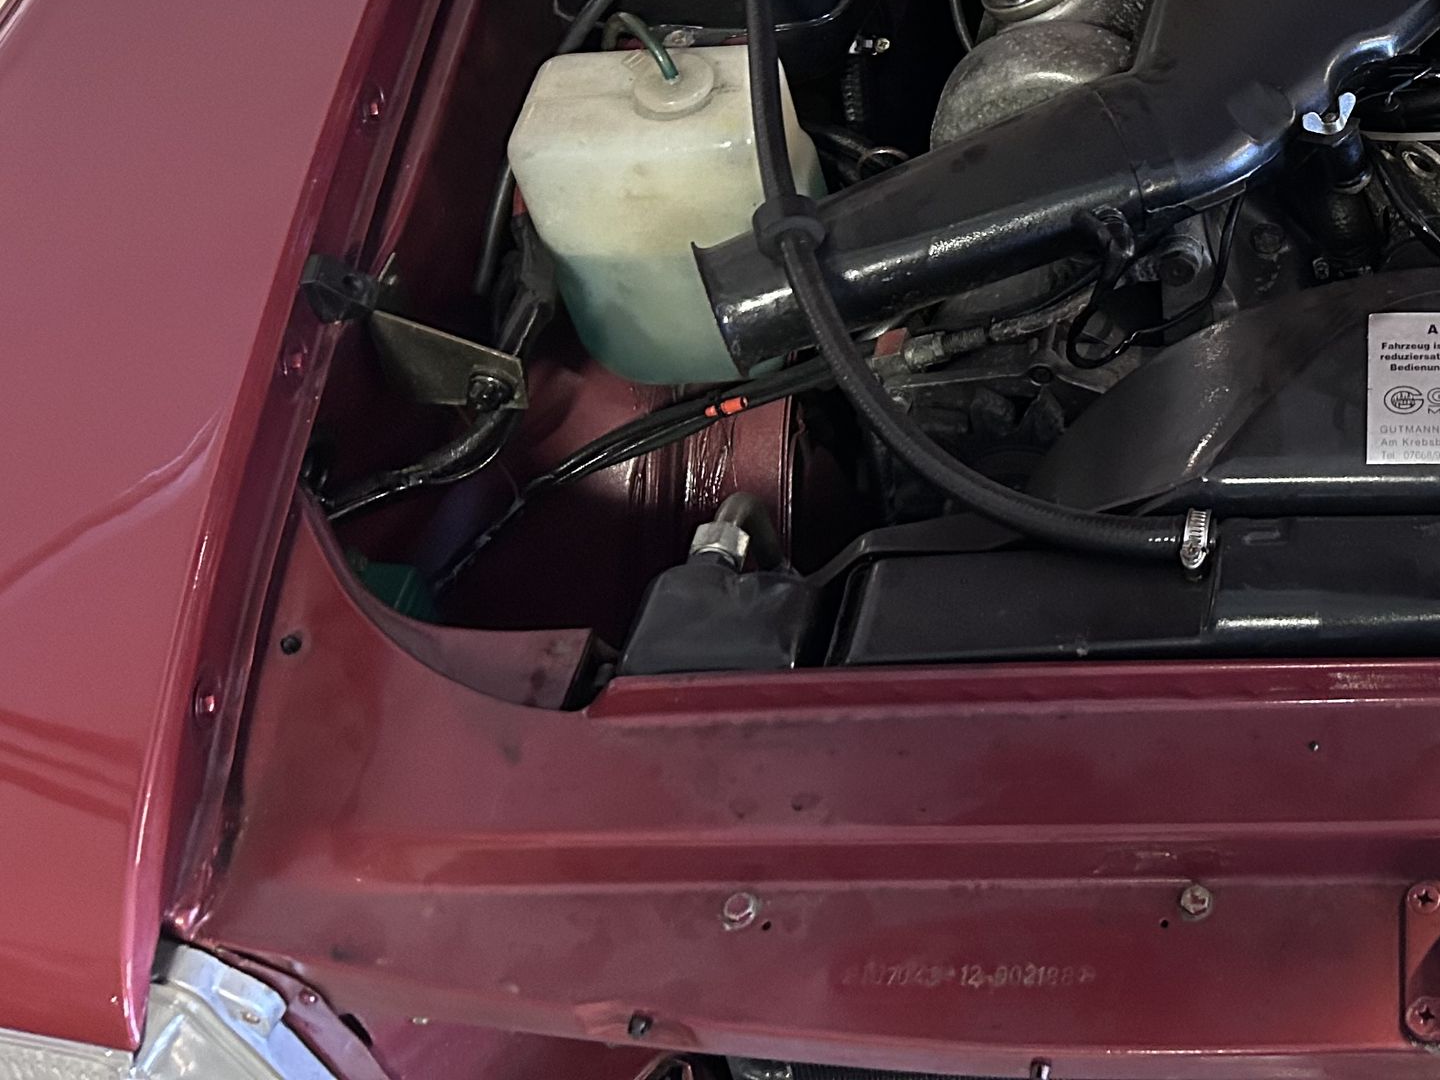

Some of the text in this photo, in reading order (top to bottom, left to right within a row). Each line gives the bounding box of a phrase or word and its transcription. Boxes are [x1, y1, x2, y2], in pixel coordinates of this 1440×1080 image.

[1381, 342, 1430, 351] Fahrzeug
[1380, 425, 1440, 434] GUTMANN
[1381, 438, 1398, 447] Am
